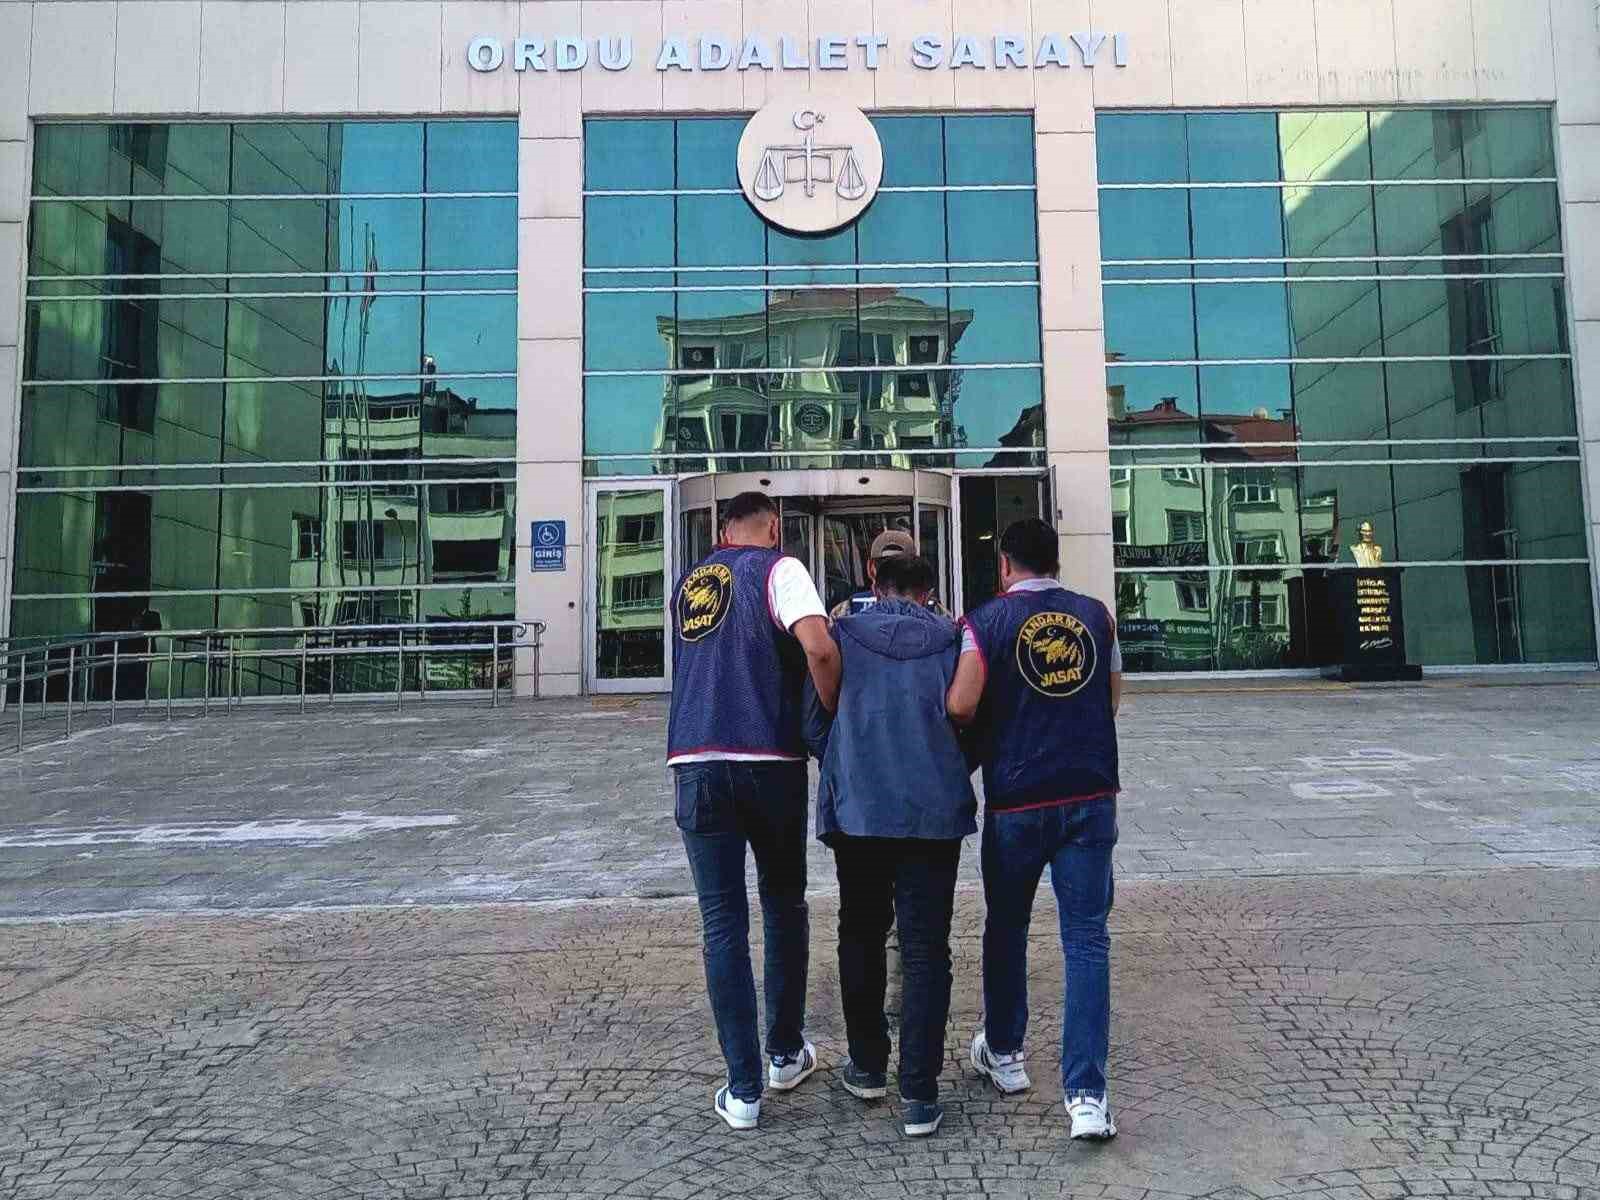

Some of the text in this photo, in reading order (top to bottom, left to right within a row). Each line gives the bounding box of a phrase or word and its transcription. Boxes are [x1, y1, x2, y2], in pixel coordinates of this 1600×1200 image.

[467, 33, 1127, 73] ORDU ADALET SARAYI
[682, 614, 714, 633] JASAT
[1021, 613, 1084, 645] JANDARMA
[1040, 667, 1083, 687] JASAT
